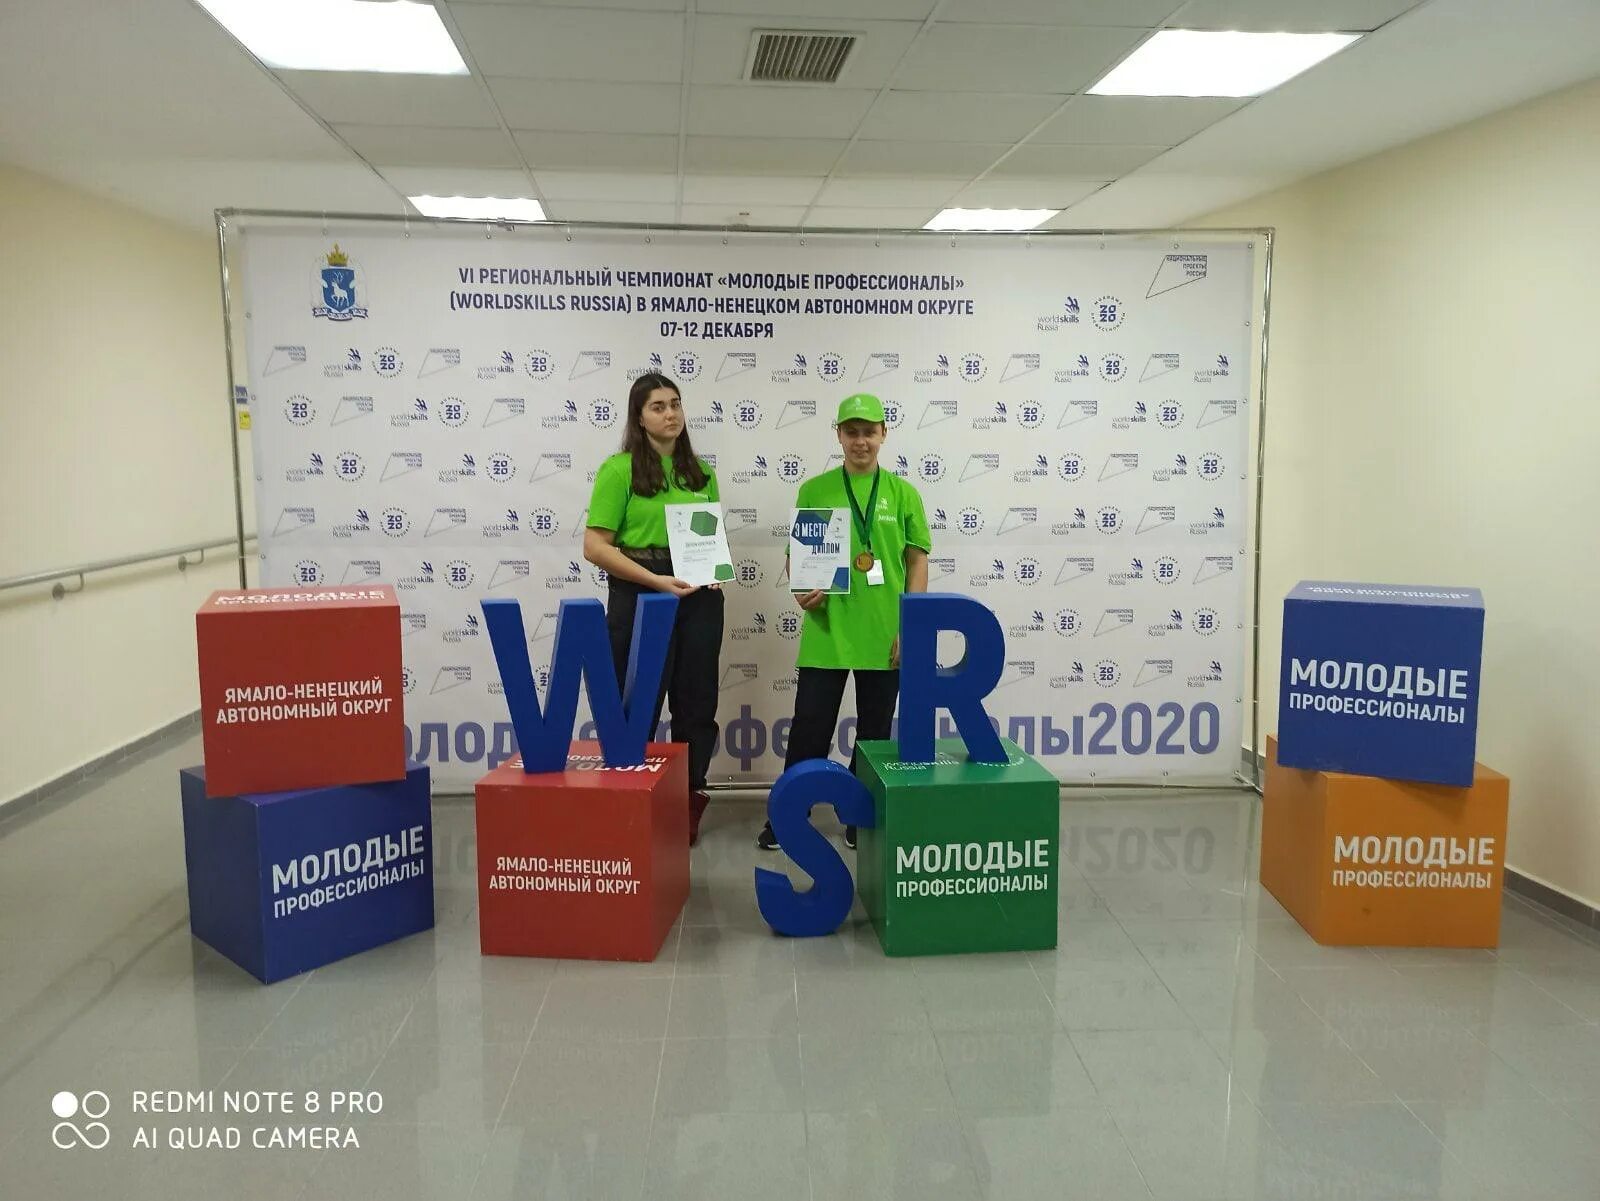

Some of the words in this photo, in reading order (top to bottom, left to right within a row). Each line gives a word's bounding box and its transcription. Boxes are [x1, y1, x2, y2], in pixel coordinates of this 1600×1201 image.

[459, 268, 475, 283] VI
[479, 267, 612, 287] РЕГИОНАЛЬНЫЙ
[617, 272, 714, 288] ЧЕМПИОНАТ
[718, 273, 810, 291] «МОЛОДЫЕ
[814, 274, 965, 291] ПРОФЕССИОНАЛЫ»
[450, 291, 566, 312] (WORLDSKILLS
[571, 295, 632, 314] RUSSIA)
[637, 297, 646, 311] В
[651, 297, 800, 316] ЯМАЛО-НЕНЕЦКОМ
[804, 299, 913, 315] АВТОНОМНОМ
[918, 299, 974, 315] ОКРУГЕ
[661, 322, 698, 337] 07-12
[702, 322, 774, 339] ДЕКАБРЯ
[225, 676, 382, 703] ЯМАЛО-НЕНЕЦКИЙ
[480, 592, 680, 774] W
[899, 592, 1006, 764] R
[1290, 658, 1468, 700] МОЛОДЫЕ
[216, 699, 337, 724] АВТОНОМНЫЙ
[342, 698, 392, 715] ОКРУГ
[1289, 693, 1465, 723] ПРОФЕССИОНАЛЫ
[272, 826, 424, 894] МОЛОДЫЕ
[755, 758, 876, 937] S
[896, 839, 1050, 874] МОЛОДЫЕ
[1334, 835, 1496, 869] МОЛОДЫЕ
[496, 857, 632, 876] ЯМАЛО-НЕНЕЦКИЙ
[1333, 869, 1492, 889] ПРОФЕССИОНАЛЫ
[274, 860, 424, 918] ПРОФЕССИОНАЛЫ
[489, 875, 591, 892] АВТОНОМНЫЙ
[595, 879, 641, 895] ОКРУГ
[896, 874, 1048, 898] ПРОФЕССИОНАЛЫ
